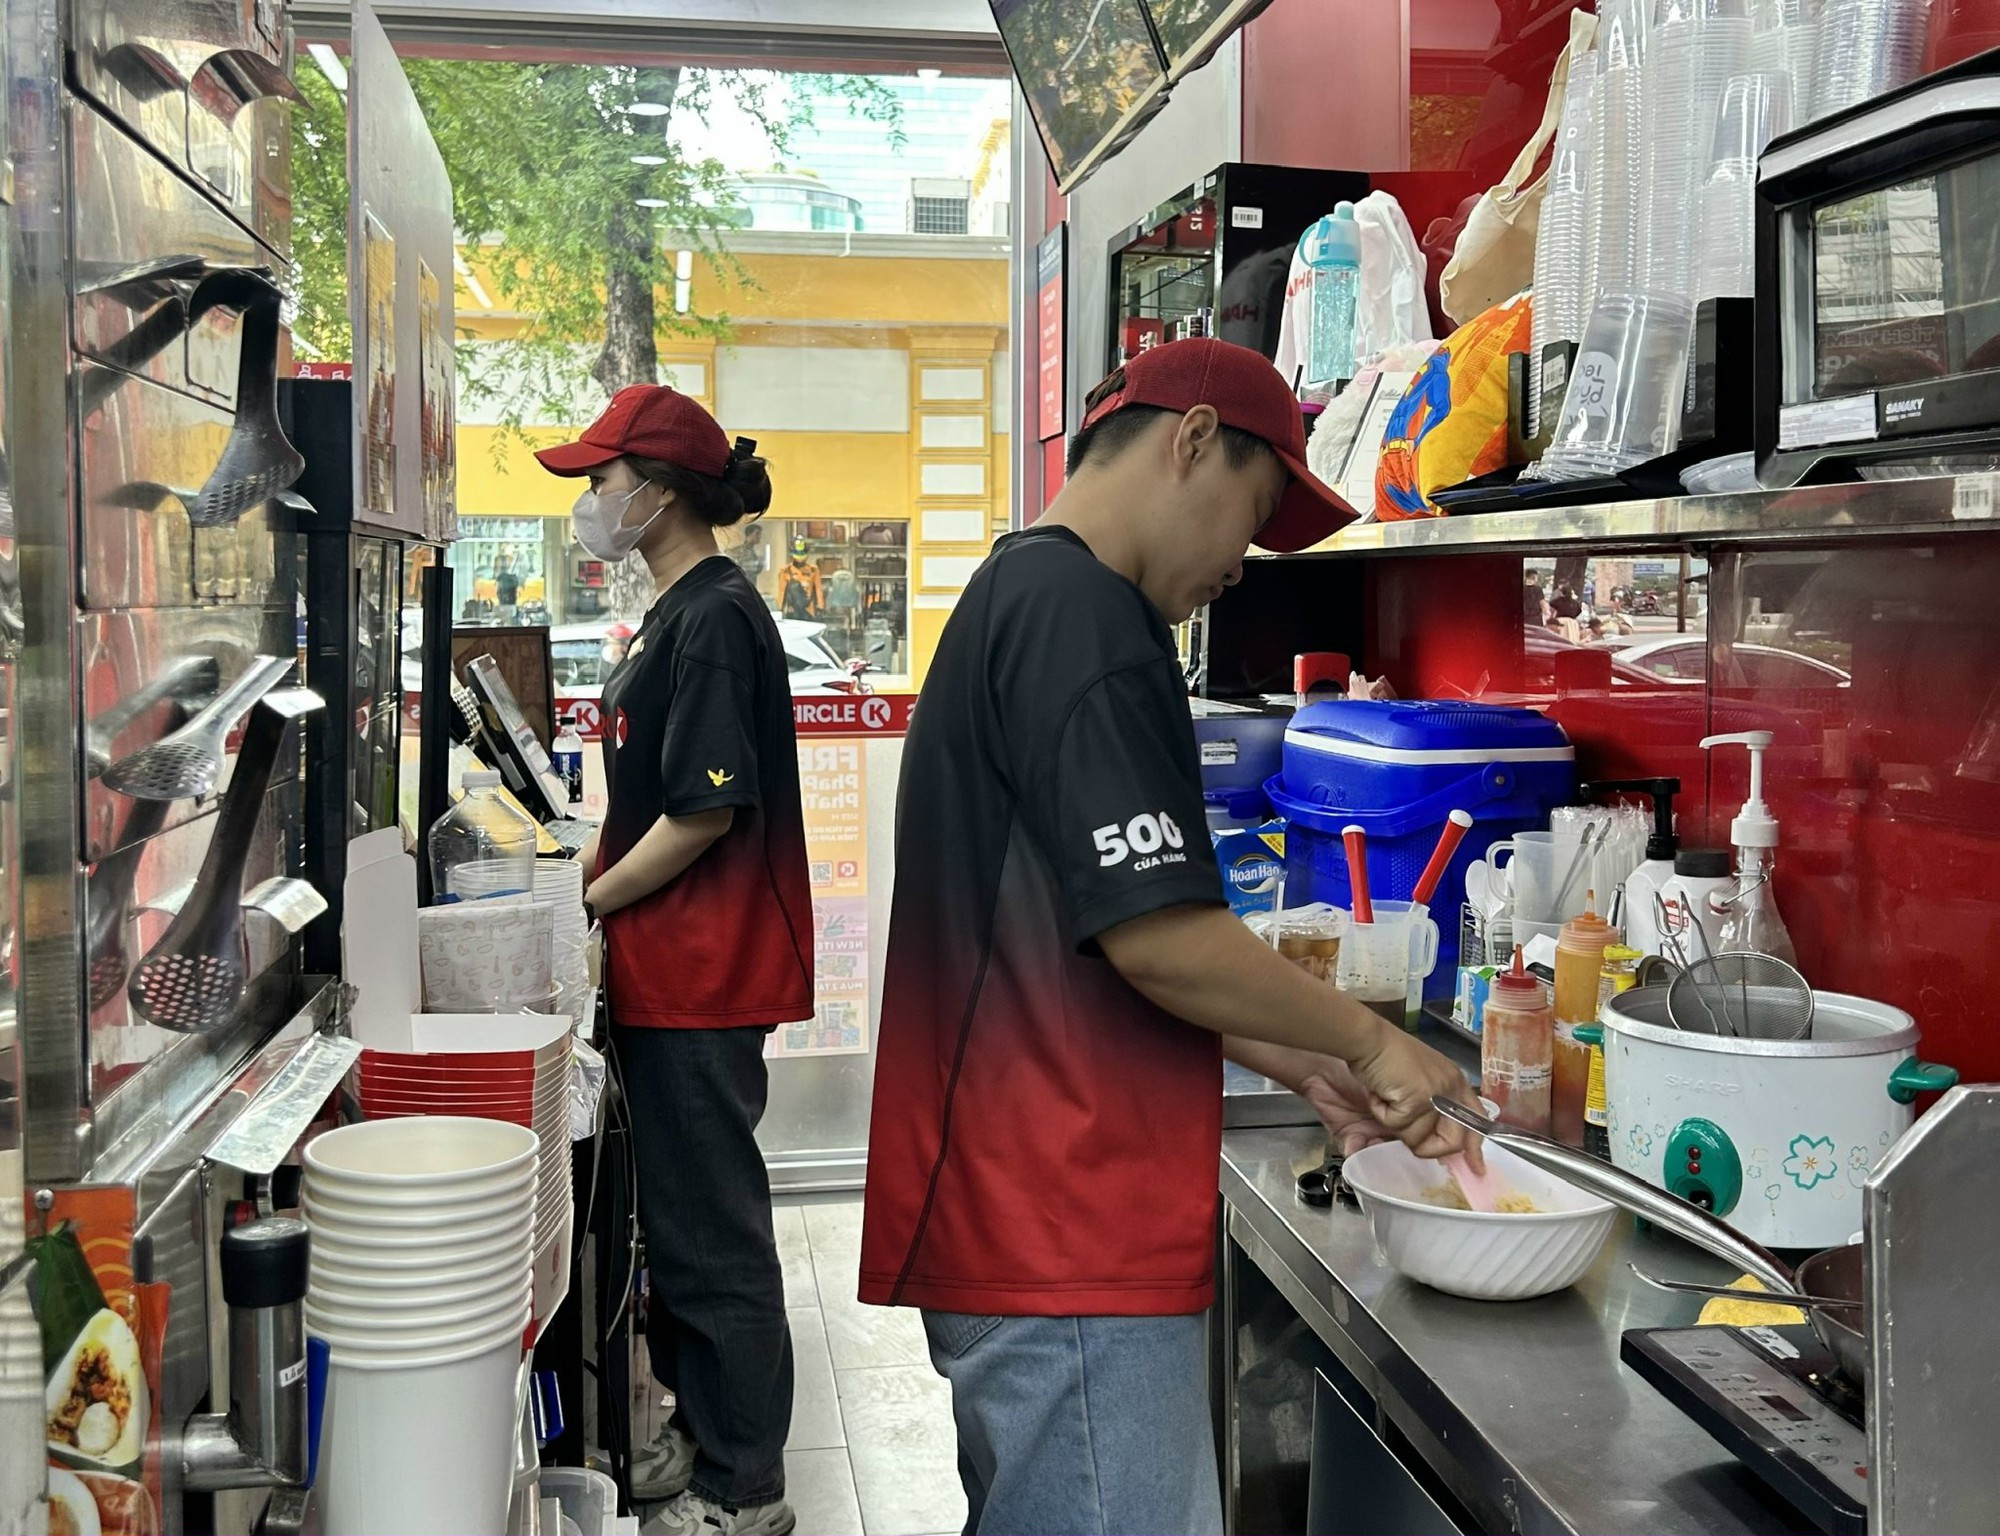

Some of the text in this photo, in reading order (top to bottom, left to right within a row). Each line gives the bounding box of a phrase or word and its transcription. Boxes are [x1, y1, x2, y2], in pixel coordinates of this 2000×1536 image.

[792, 704, 856, 723] IRCLE
[1092, 811, 1184, 867] 500
[1663, 1073, 1742, 1097] SHARP
